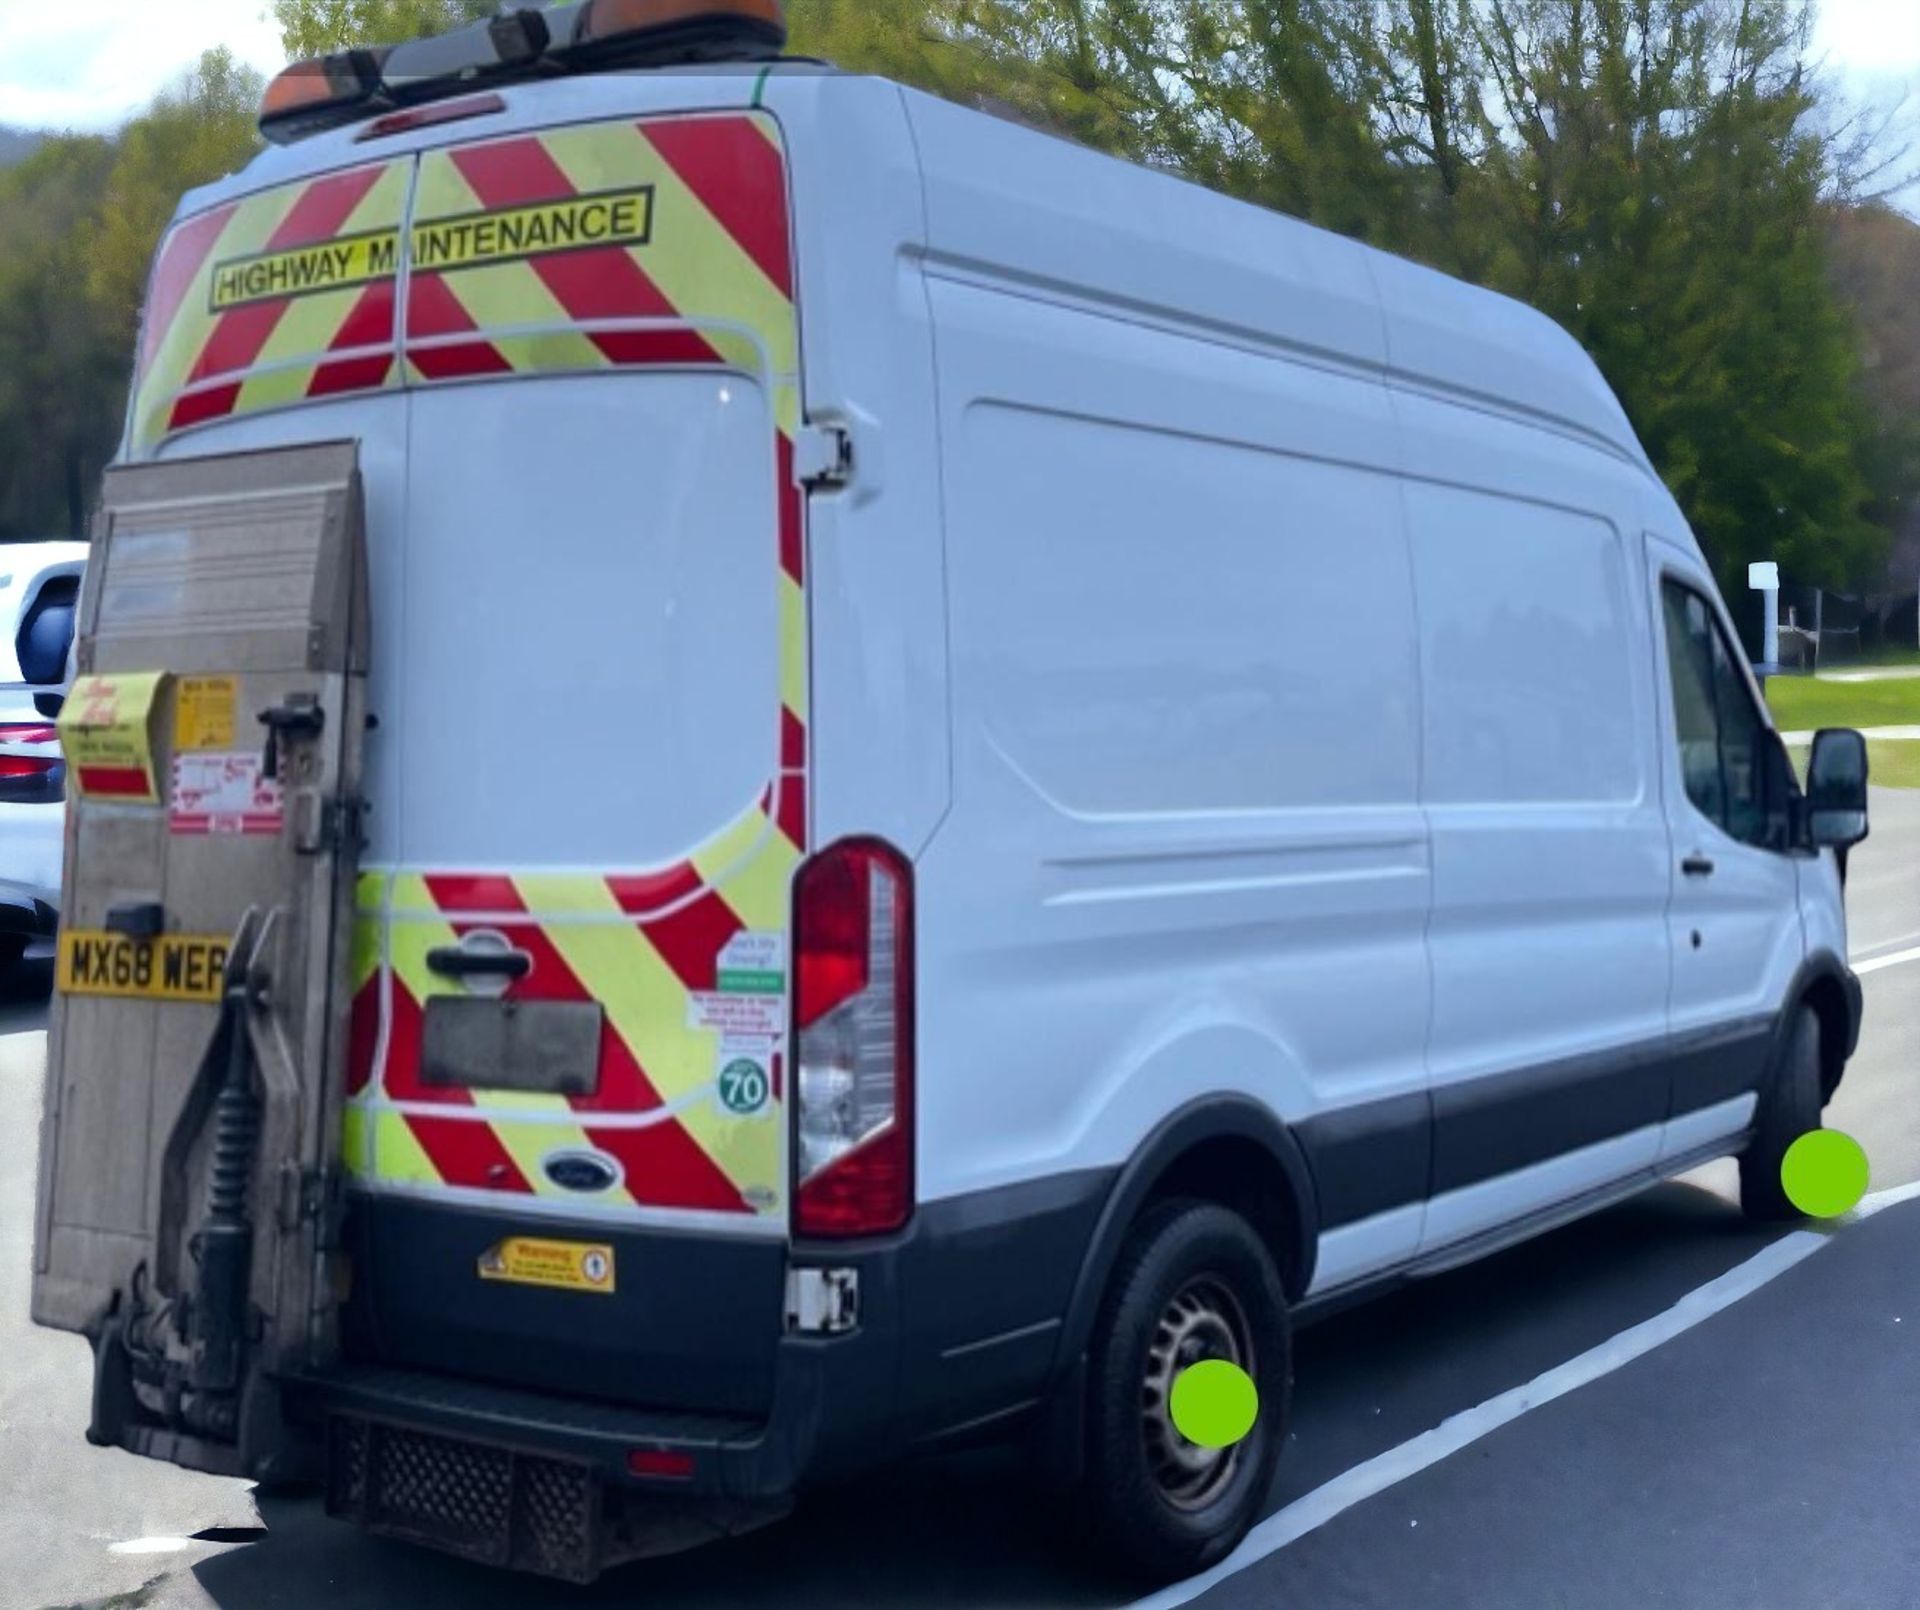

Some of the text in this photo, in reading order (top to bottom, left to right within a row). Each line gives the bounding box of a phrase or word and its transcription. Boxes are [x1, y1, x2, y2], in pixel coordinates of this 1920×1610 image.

[218, 200, 637, 301] HIGHWAY MINTENANCE
[71, 939, 152, 987] MX68
[724, 1072, 763, 1103] 70
